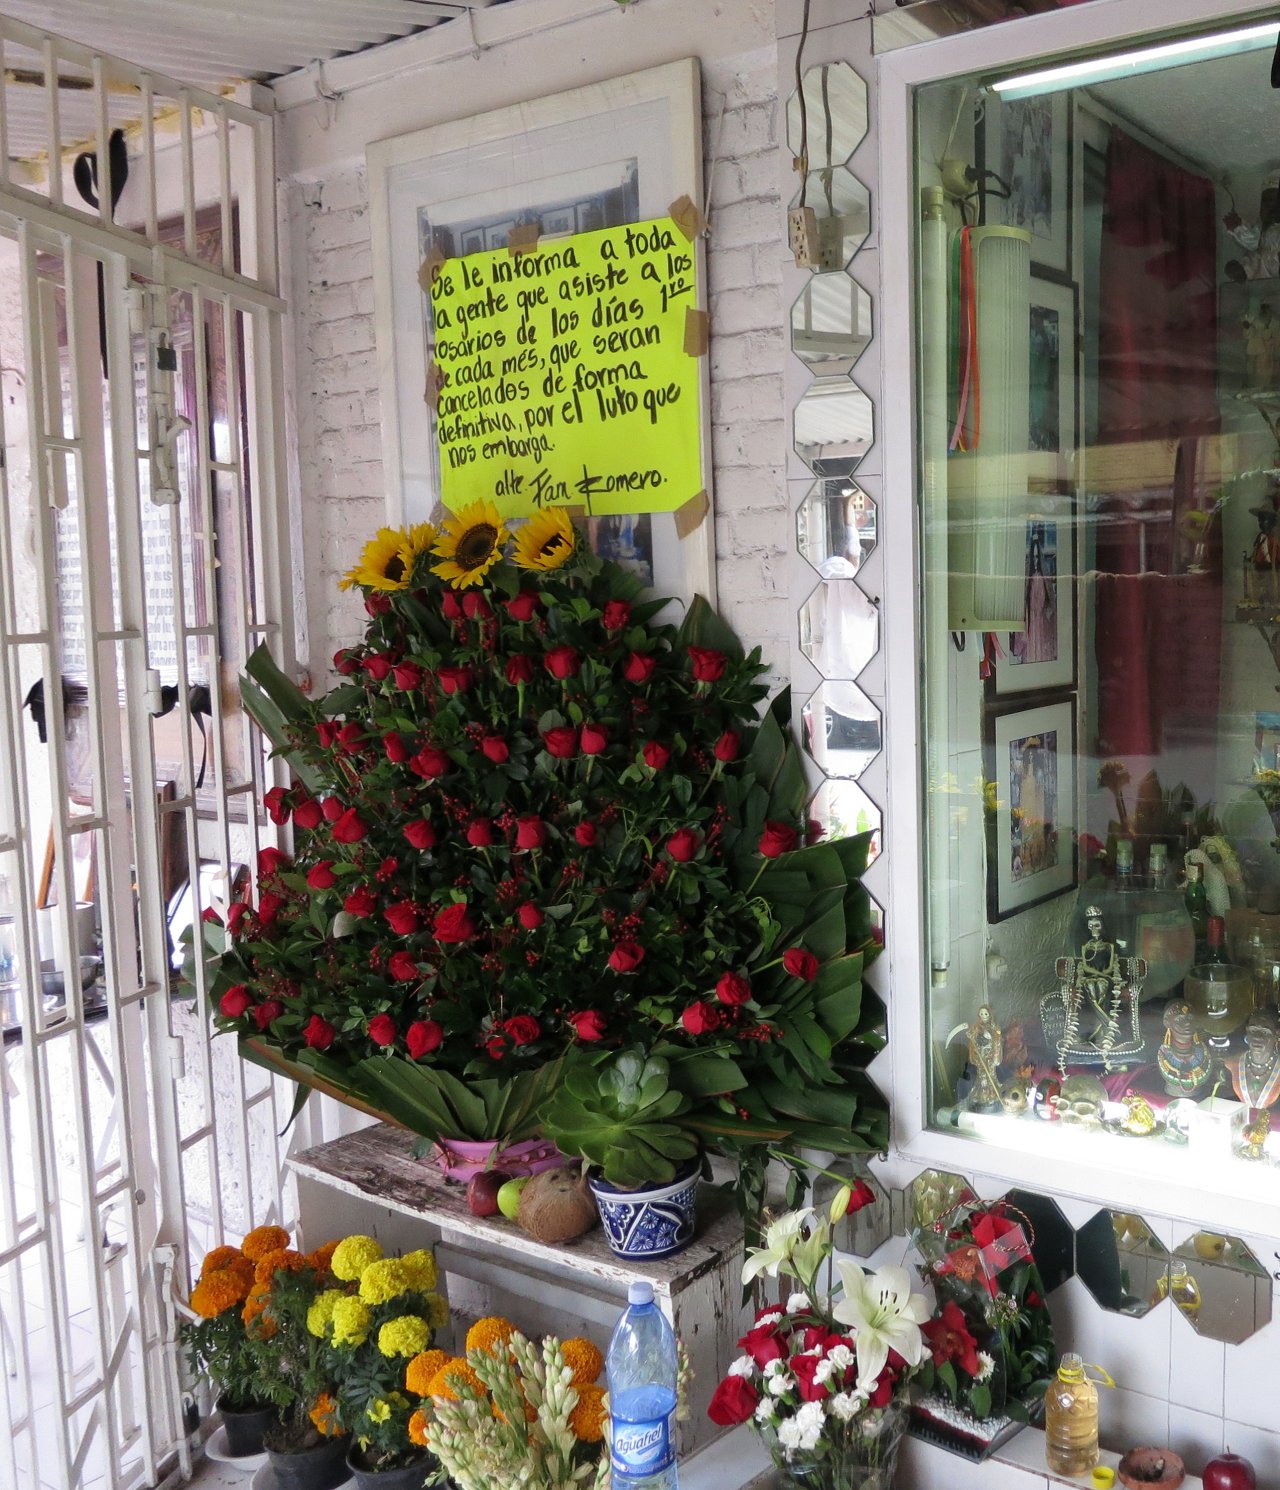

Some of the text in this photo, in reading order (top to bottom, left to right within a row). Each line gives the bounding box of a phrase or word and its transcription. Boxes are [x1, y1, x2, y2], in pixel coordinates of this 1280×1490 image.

[432, 224, 676, 300] Se le informa a toda
[433, 252, 692, 340] la gente que asiste a los
[434, 329, 506, 361] rosarios
[517, 315, 538, 345] de
[551, 307, 579, 338] los
[592, 296, 644, 328] días
[455, 361, 495, 389] cada
[550, 339, 581, 372] que
[593, 324, 660, 354] seran
[437, 360, 648, 419] cancelados de forma
[439, 382, 681, 445] definitiva, por el luto que
[448, 434, 556, 468] nos embarga.
[616, 1425, 662, 1455] aguafiel
